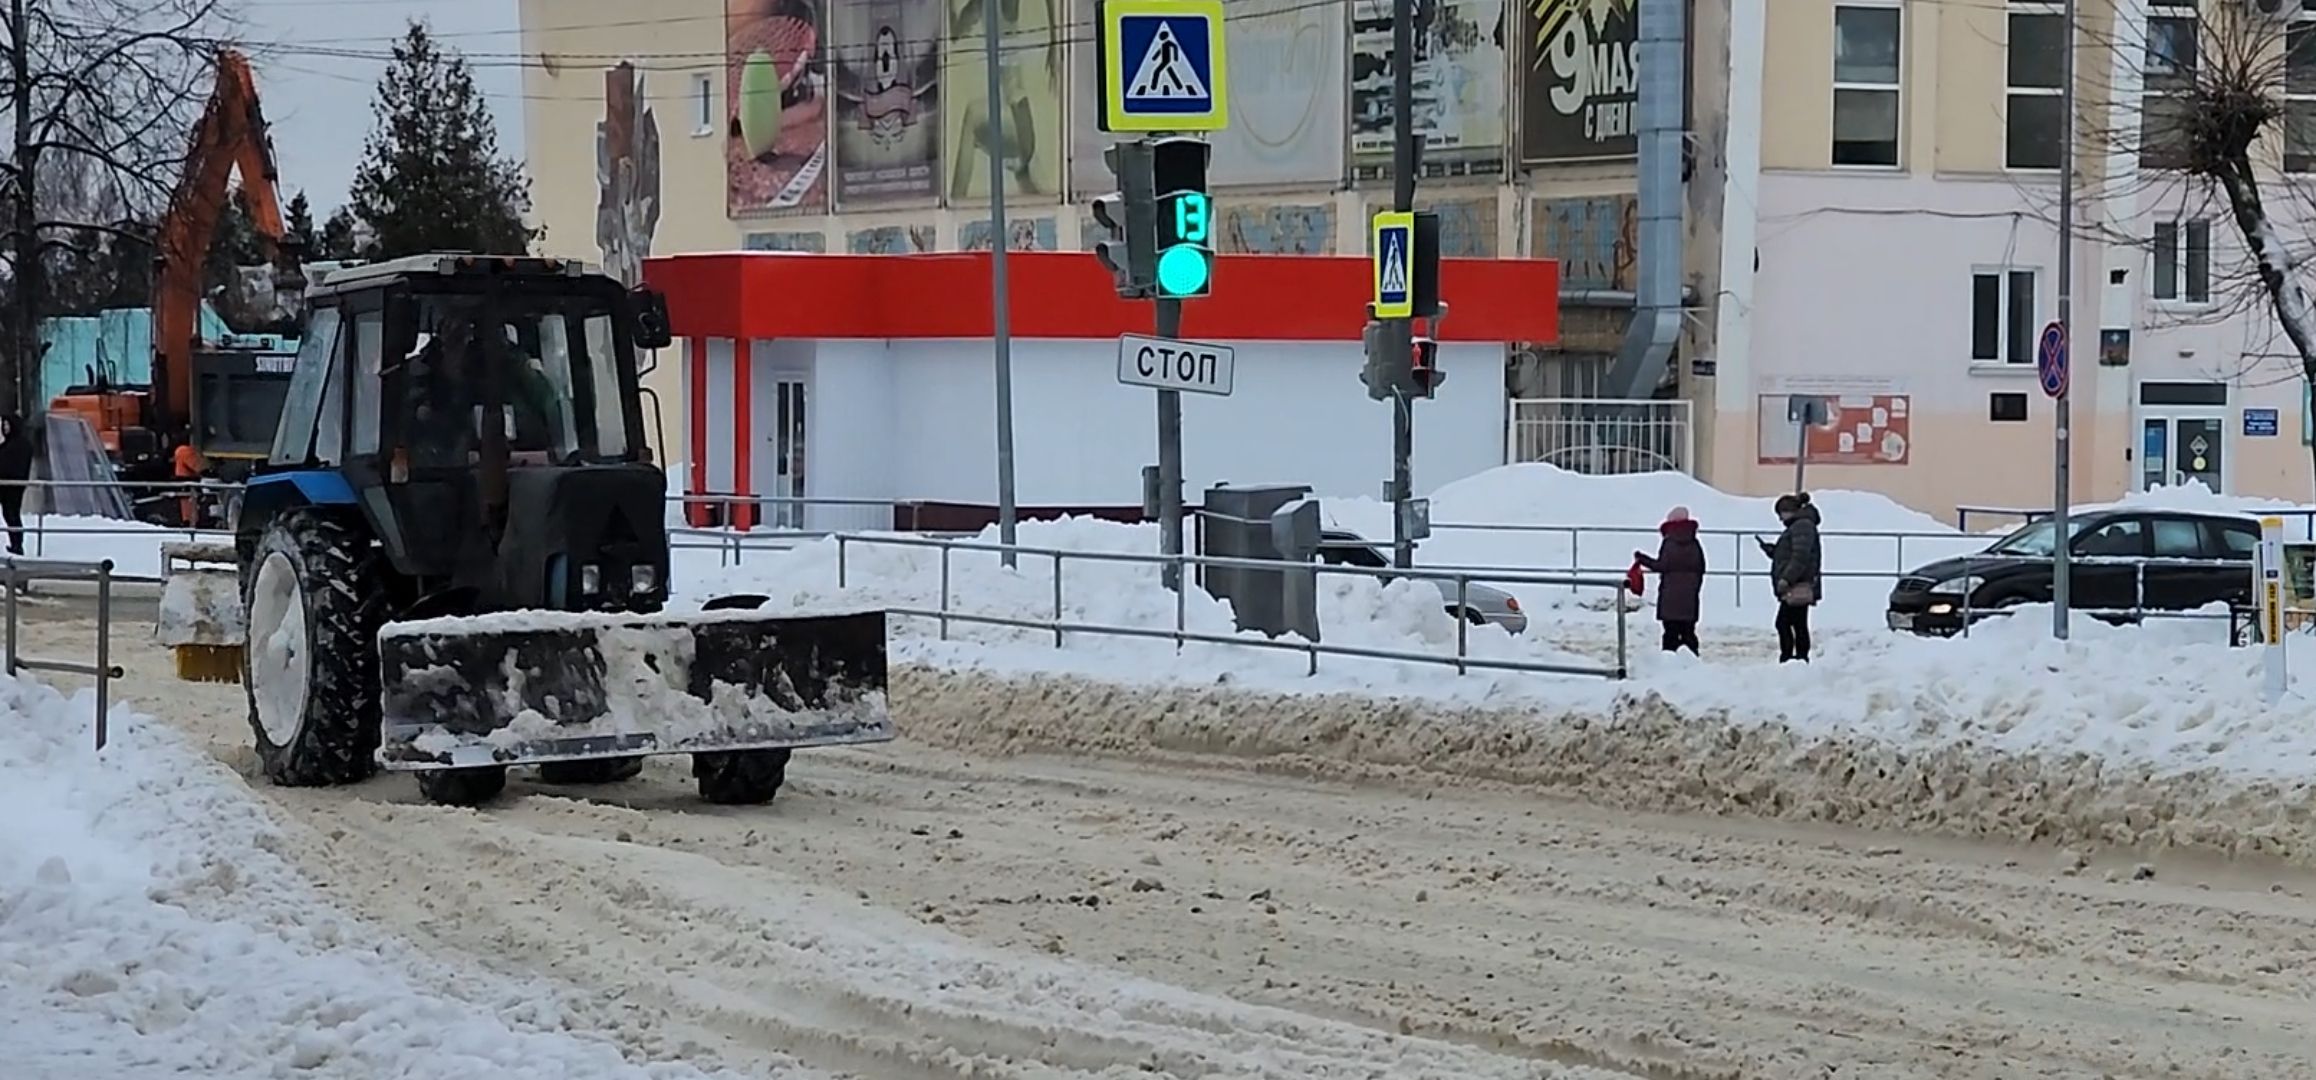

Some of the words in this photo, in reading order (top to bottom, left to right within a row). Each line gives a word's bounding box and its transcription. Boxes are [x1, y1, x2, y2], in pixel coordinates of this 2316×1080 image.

[1549, 10, 1588, 115] 9
[1586, 41, 1640, 96] МАЯ
[1585, 104, 1594, 139] С
[1175, 194, 1206, 241] 13
[1137, 346, 1217, 386] СТОП
